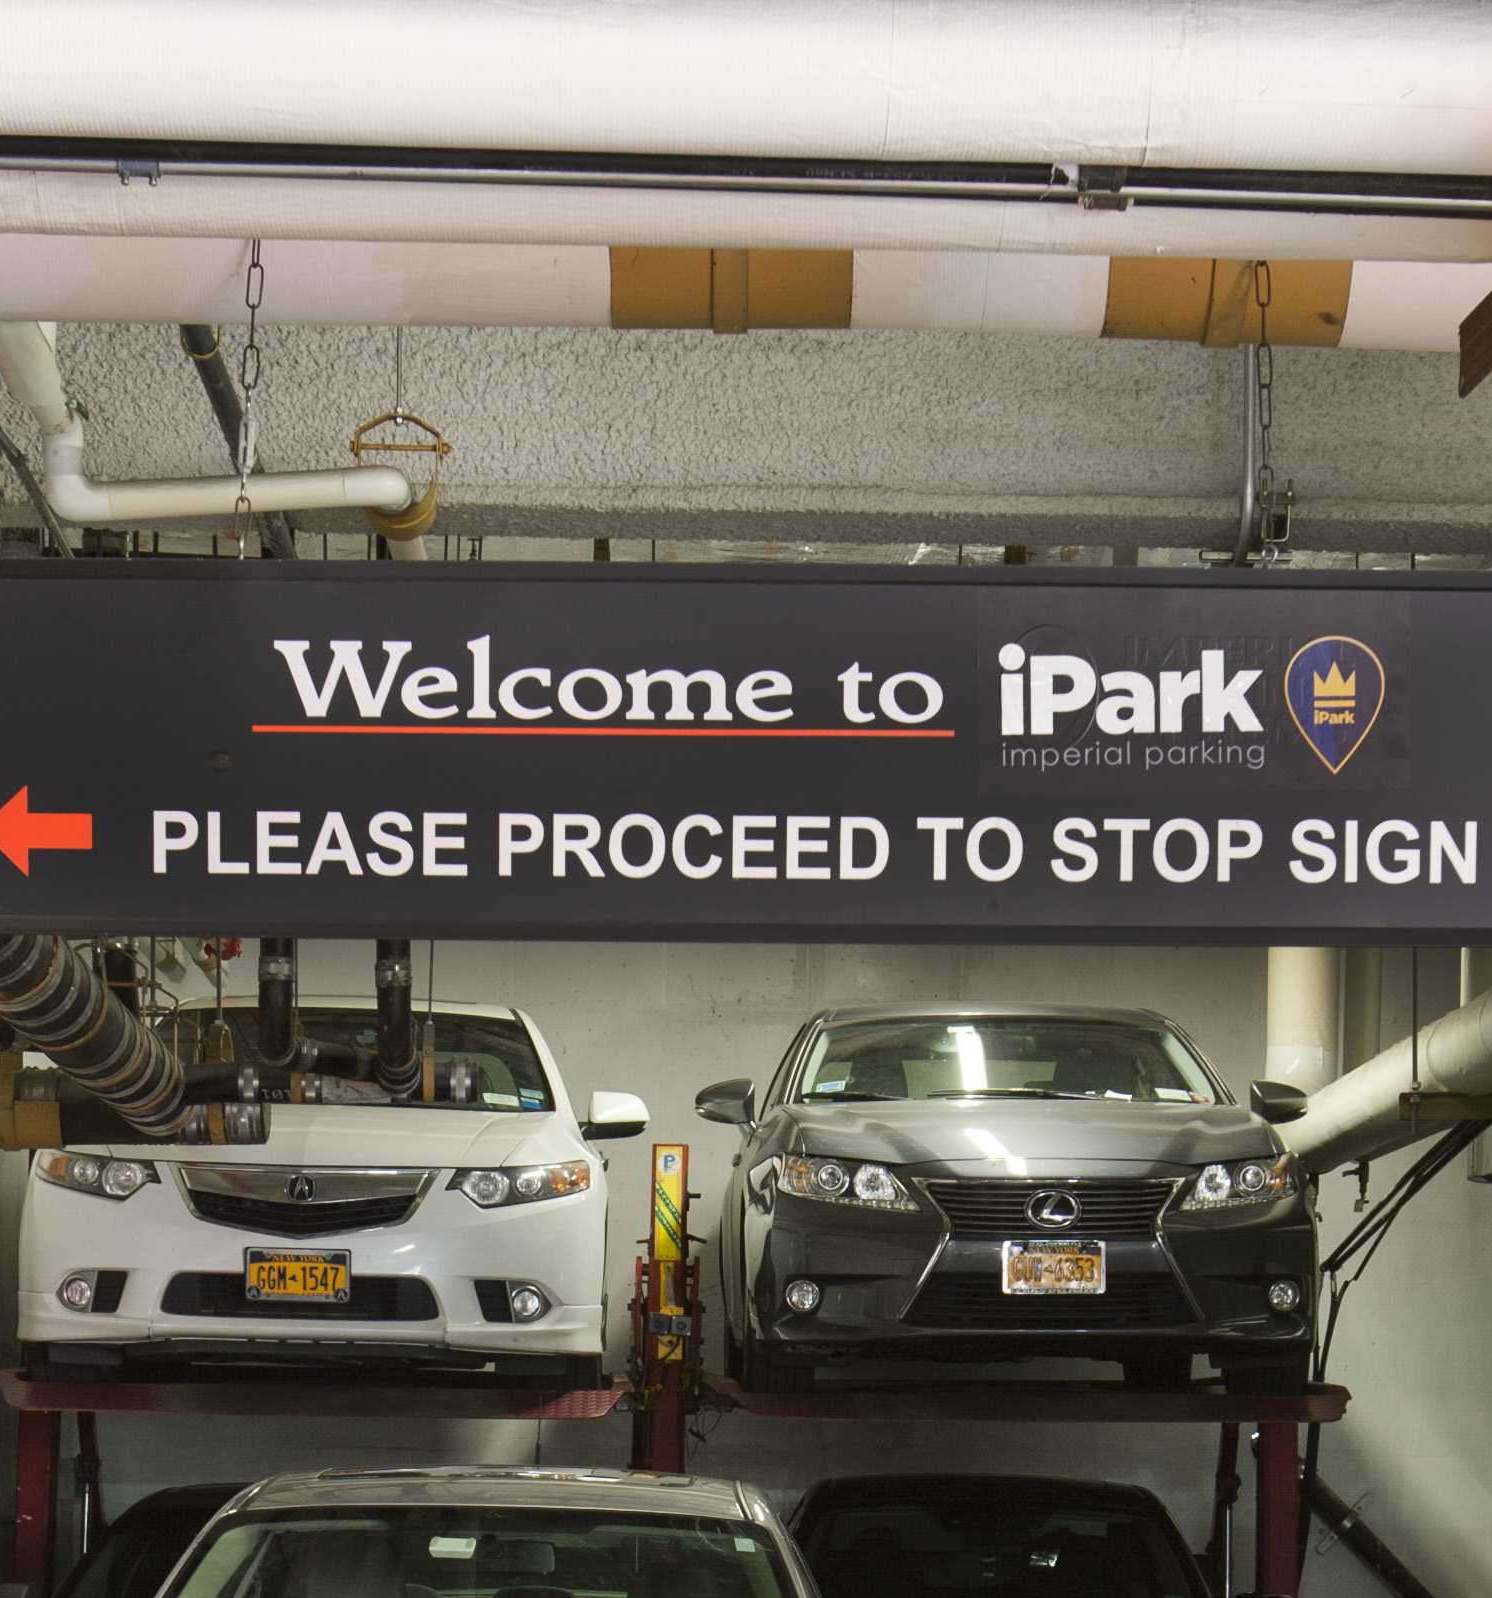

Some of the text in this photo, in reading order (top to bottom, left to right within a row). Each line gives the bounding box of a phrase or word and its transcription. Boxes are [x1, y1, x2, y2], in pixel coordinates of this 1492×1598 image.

[274, 635, 943, 723] Welcome to
[999, 644, 1263, 735] iPark
[1313, 709, 1356, 725] iPark
[1002, 740, 1265, 771] imperial parking
[154, 811, 1477, 885] PLEASE PROCEED TO STOP SIGN
[301, 1265, 340, 1291] 1547
